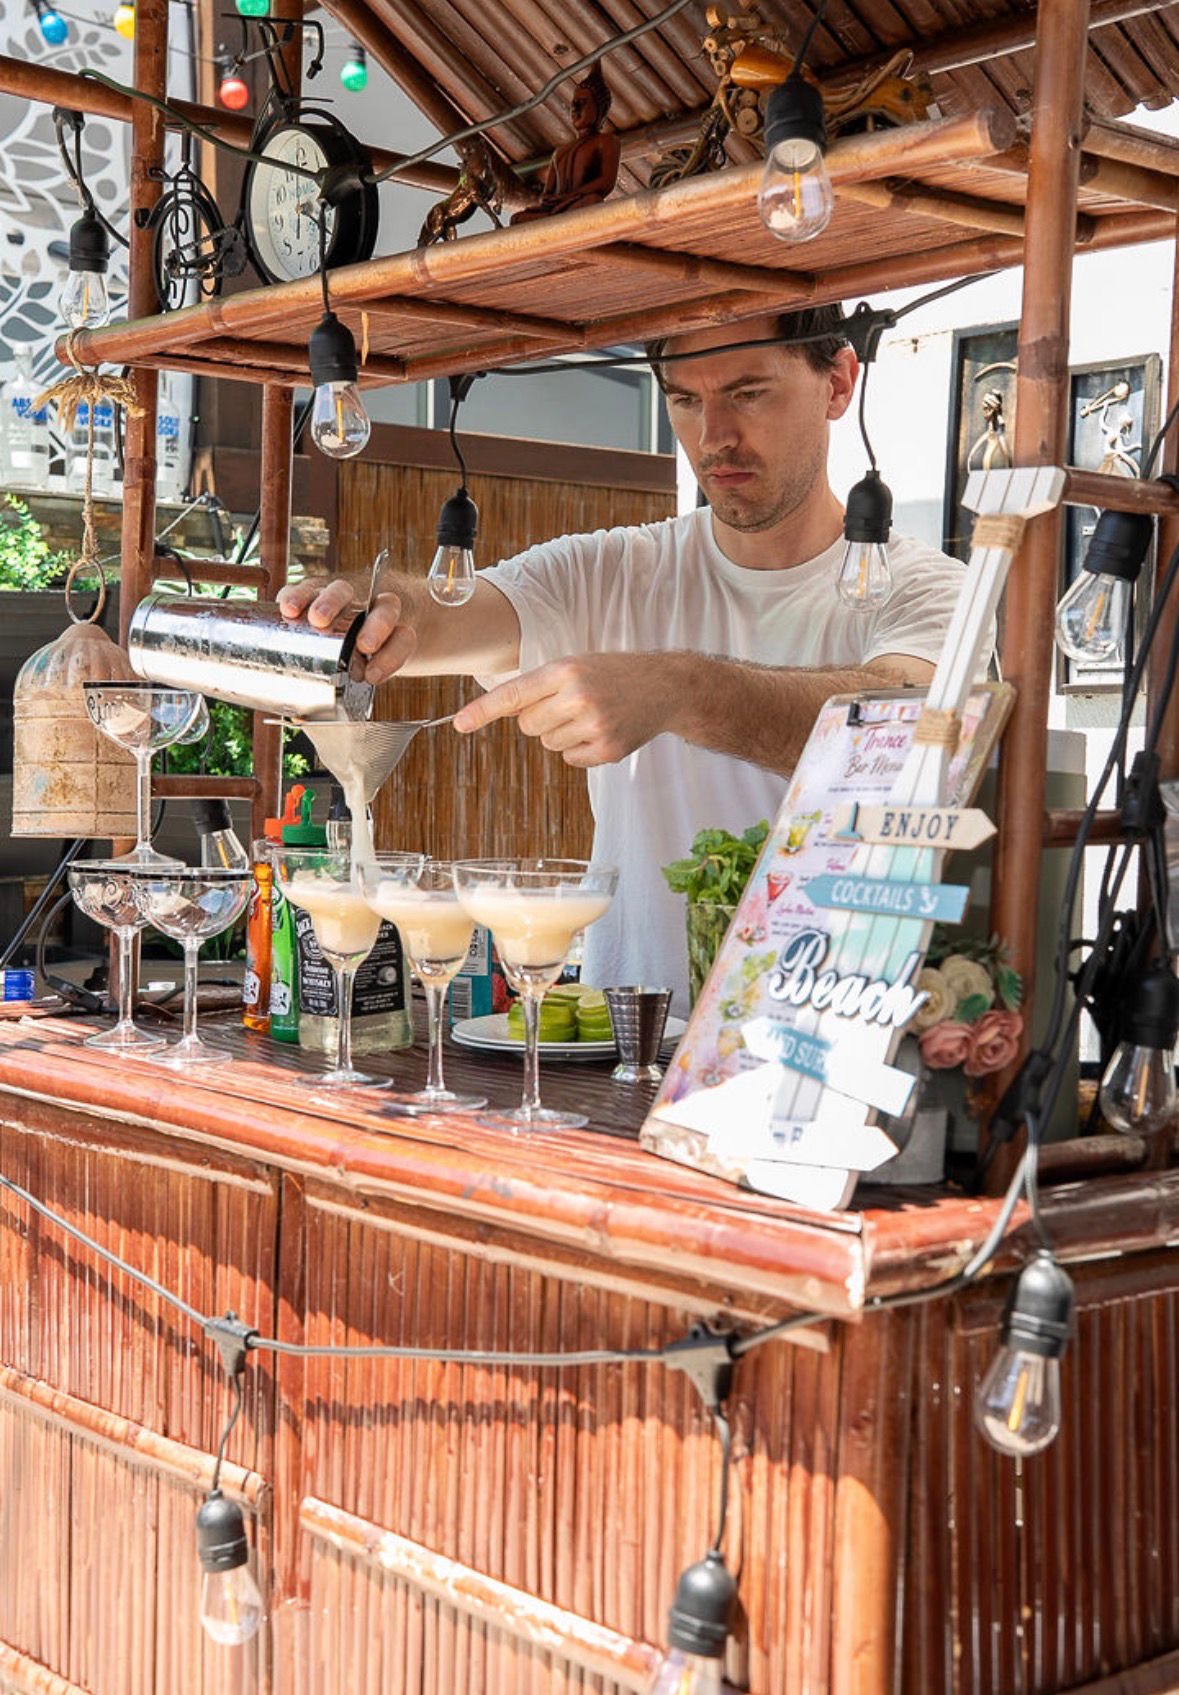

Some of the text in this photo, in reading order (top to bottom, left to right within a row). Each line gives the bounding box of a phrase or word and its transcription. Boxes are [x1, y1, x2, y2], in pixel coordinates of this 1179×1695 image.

[879, 812, 960, 840] ENJOY
[831, 878, 914, 912] COCKTAILS
[767, 928, 931, 1029] Beach
